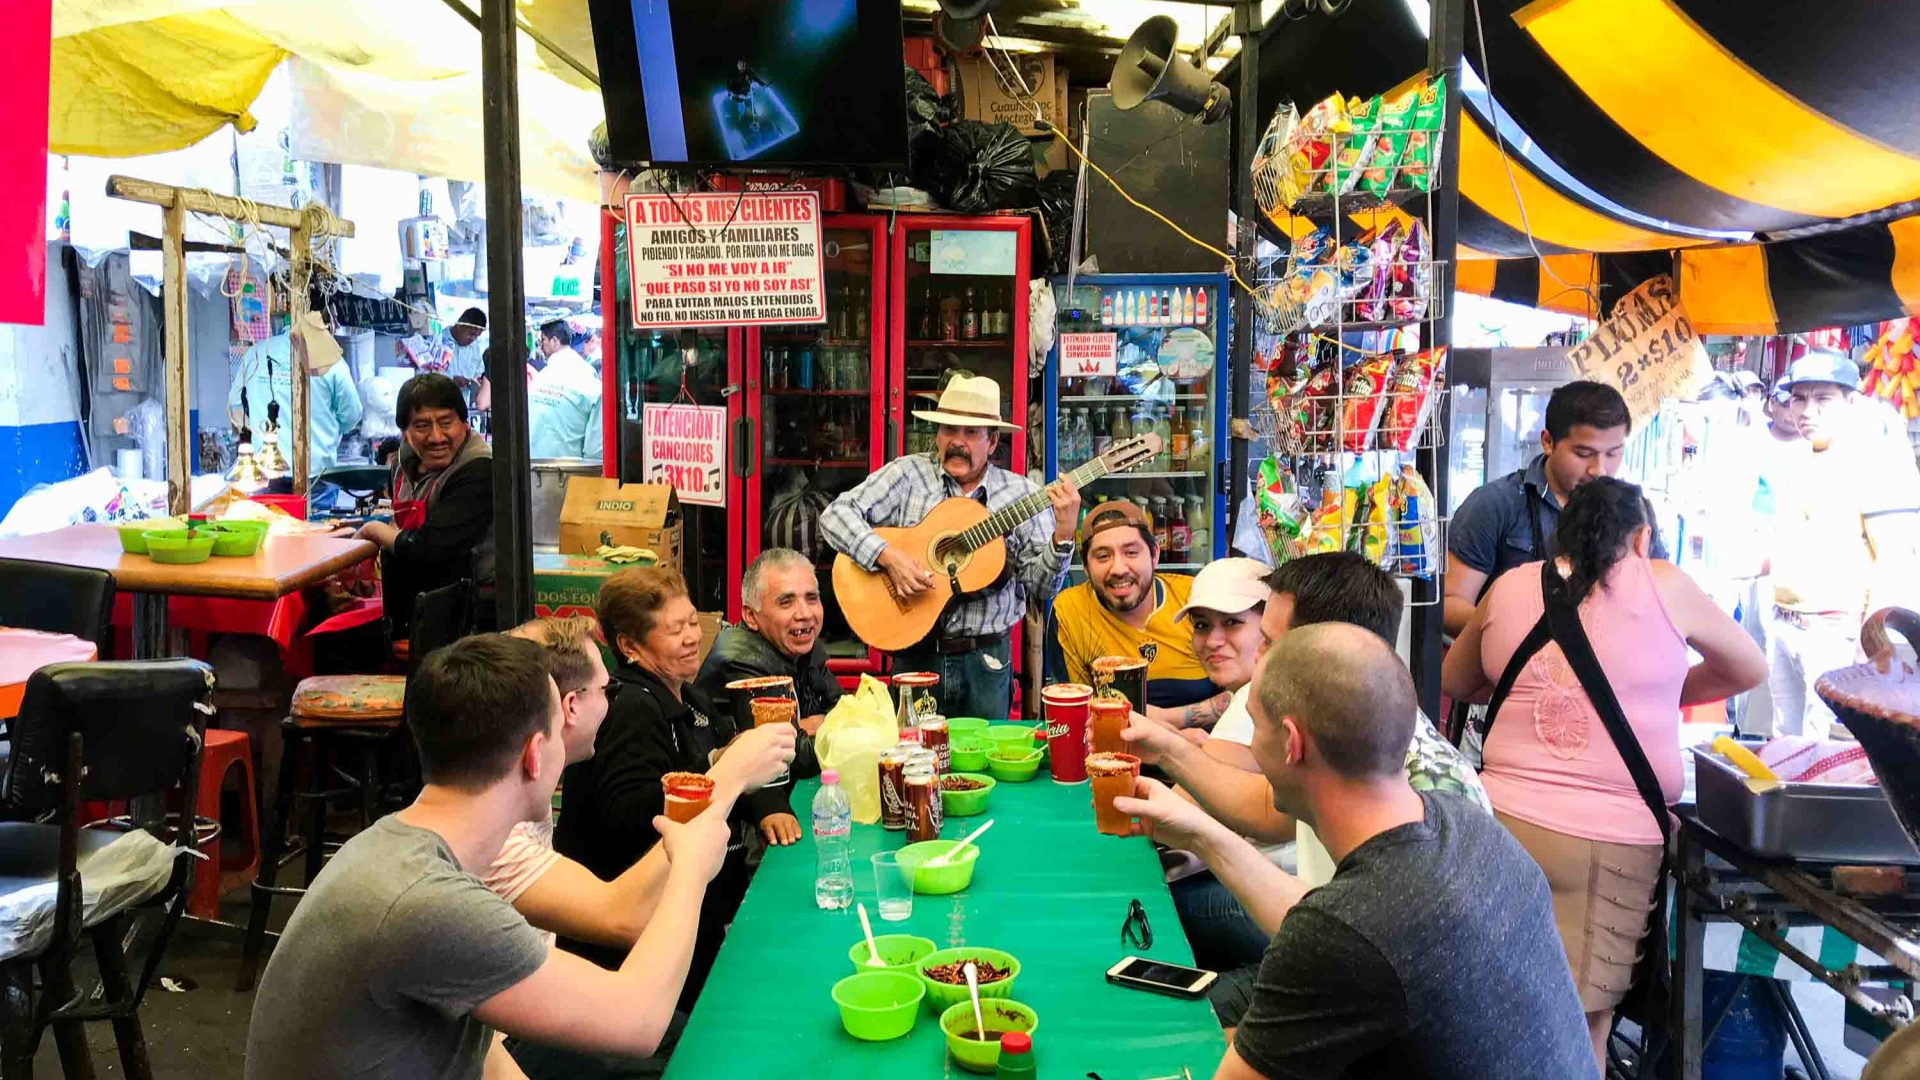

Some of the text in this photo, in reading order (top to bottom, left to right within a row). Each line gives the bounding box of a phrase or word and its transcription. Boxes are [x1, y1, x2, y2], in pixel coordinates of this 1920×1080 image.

[635, 197, 812, 224] A TODOS MIS CLIENTES
[651, 226, 800, 245] AMIGOS Y FAMILIARES
[642, 246, 679, 261] PIDIENDO
[678, 246, 686, 260] Y
[726, 244, 742, 259] POR
[742, 243, 768, 258] FAVOR
[768, 243, 778, 257] NO
[779, 243, 791, 257] ME
[791, 242, 815, 257] DIGAS
[686, 264, 705, 276] NO
[708, 263, 728, 275] ME
[731, 262, 758, 275] VOY
[761, 262, 770, 274] A
[674, 281, 705, 294] PASO
[709, 280, 722, 292] SI
[724, 279, 740, 293] YO
[743, 279, 760, 292] NO
[763, 278, 787, 291] SOY
[645, 294, 814, 309] PARA EVITAR MALOS ENTENDIDOS
[641, 306, 820, 323] NO FIO, NO INSISTA NO ME HAGA ENOJAR.
[652, 440, 713, 464] CANCIONES
[665, 464, 703, 492] 3X10
[599, 500, 632, 511] INDIO
[537, 592, 568, 603] DOS
